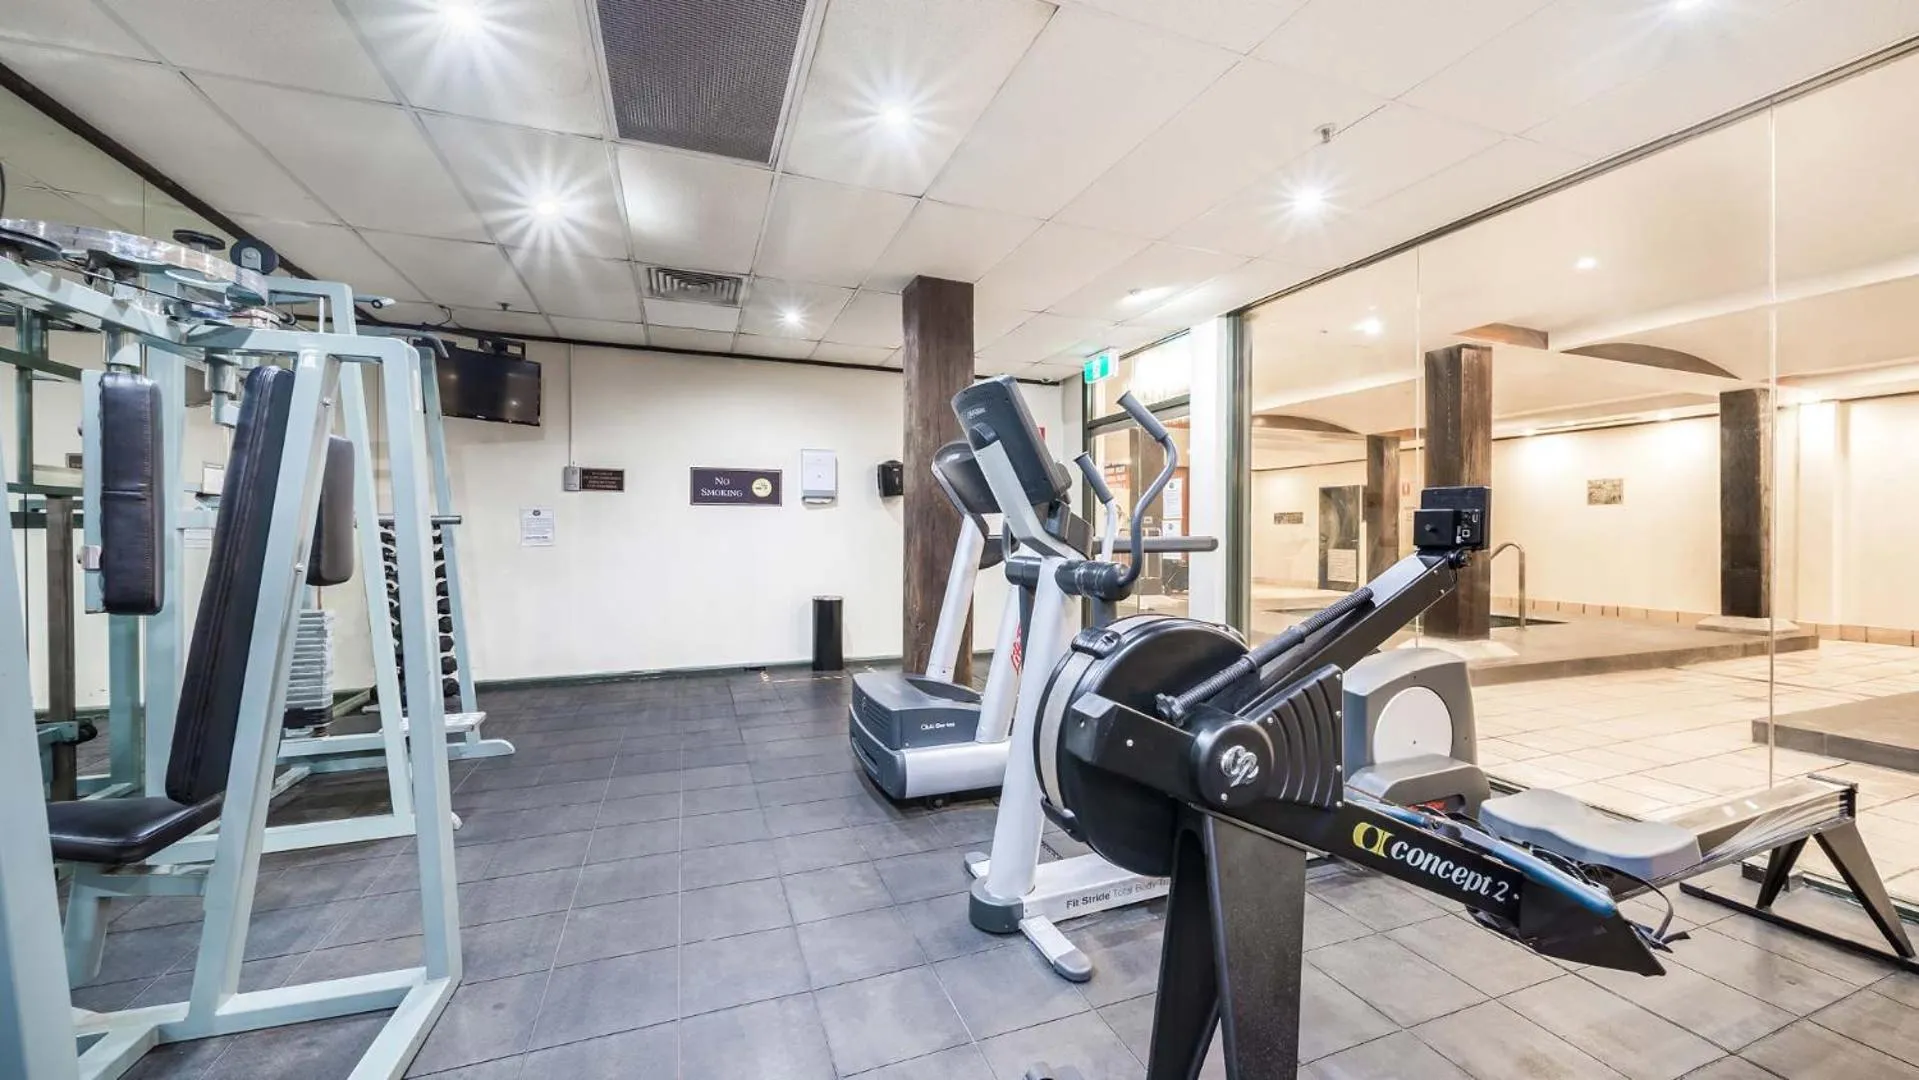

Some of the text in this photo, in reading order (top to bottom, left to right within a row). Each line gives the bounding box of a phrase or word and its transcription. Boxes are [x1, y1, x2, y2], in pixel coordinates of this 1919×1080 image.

[1390, 841, 1509, 902] concept 2
[1066, 899, 1080, 909] Fit
[1081, 892, 1111, 906] Stride
